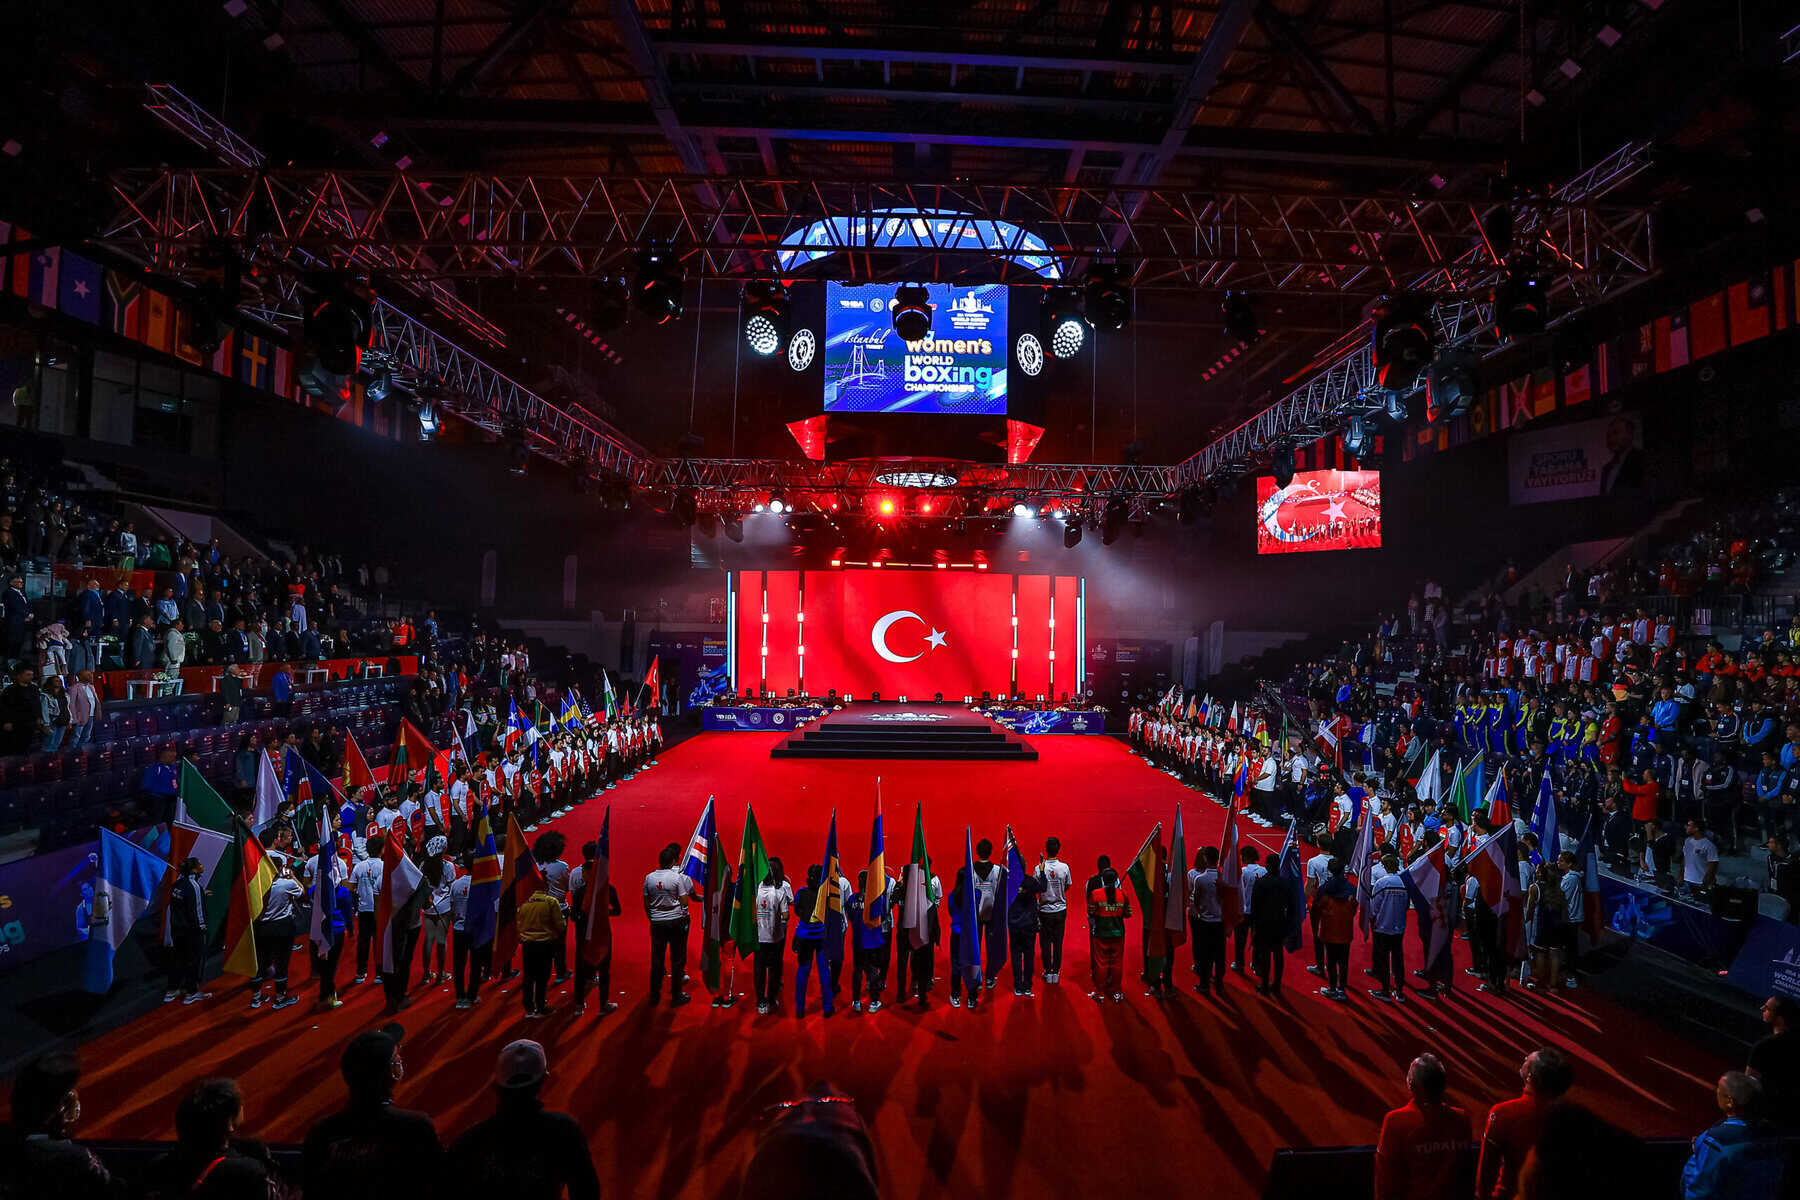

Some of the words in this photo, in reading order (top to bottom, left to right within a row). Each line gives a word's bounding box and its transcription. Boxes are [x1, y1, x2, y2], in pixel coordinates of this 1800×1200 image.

[906, 338, 992, 354] women's
[912, 355, 954, 366] WORLD
[904, 355, 992, 389] boxing
[904, 383, 975, 393] CHAMPIONSHIPS
